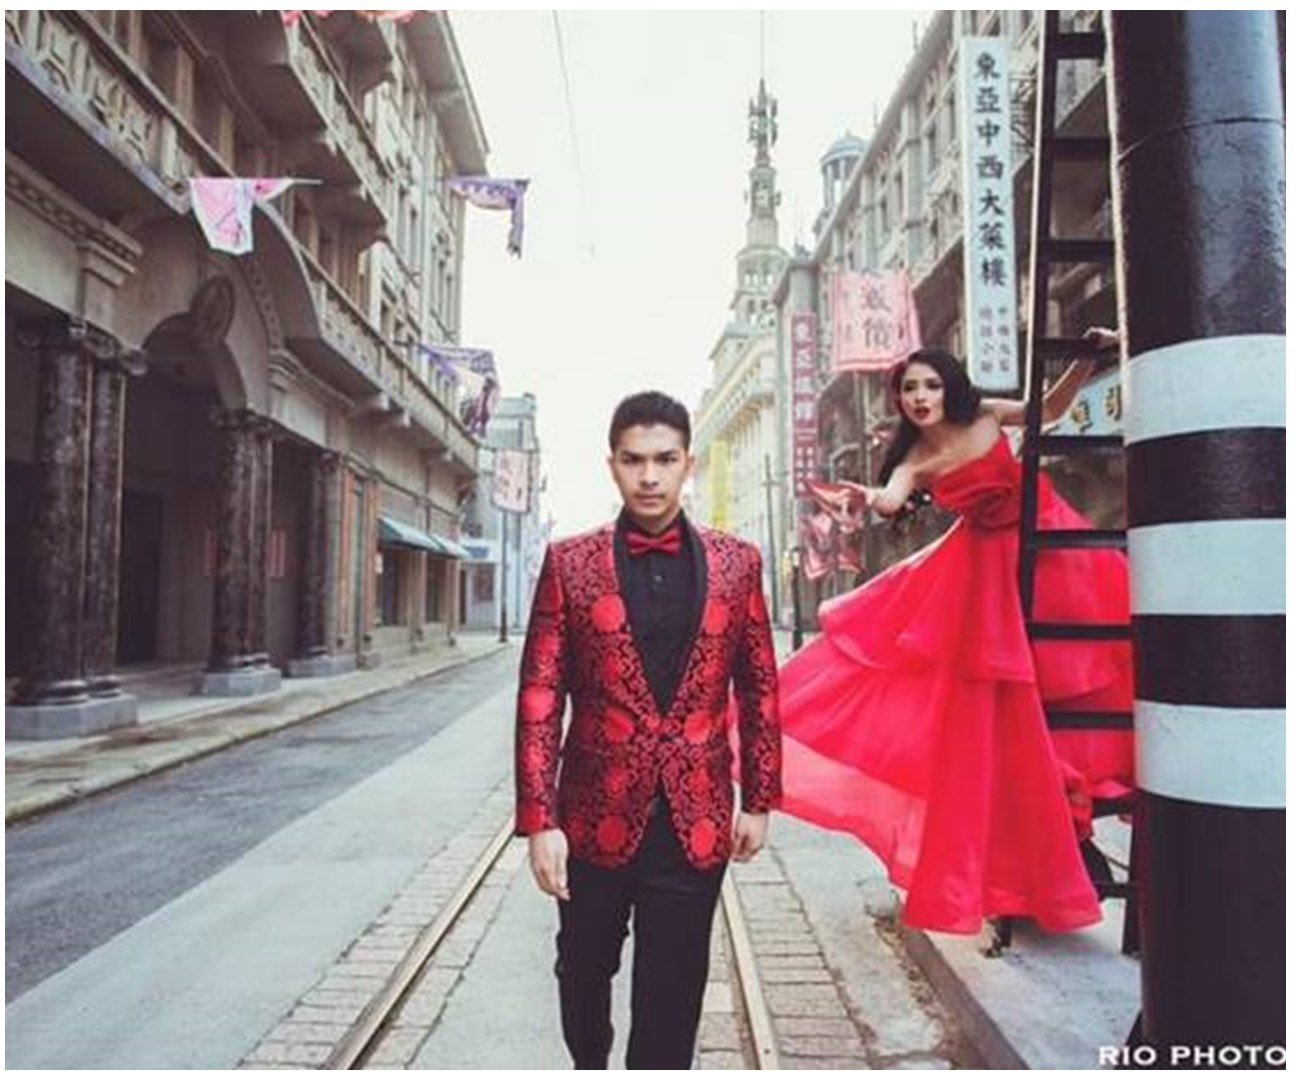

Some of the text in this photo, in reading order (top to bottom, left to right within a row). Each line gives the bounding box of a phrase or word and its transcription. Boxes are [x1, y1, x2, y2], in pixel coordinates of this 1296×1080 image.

[975, 52, 1007, 287] 東亞中西大菜樓
